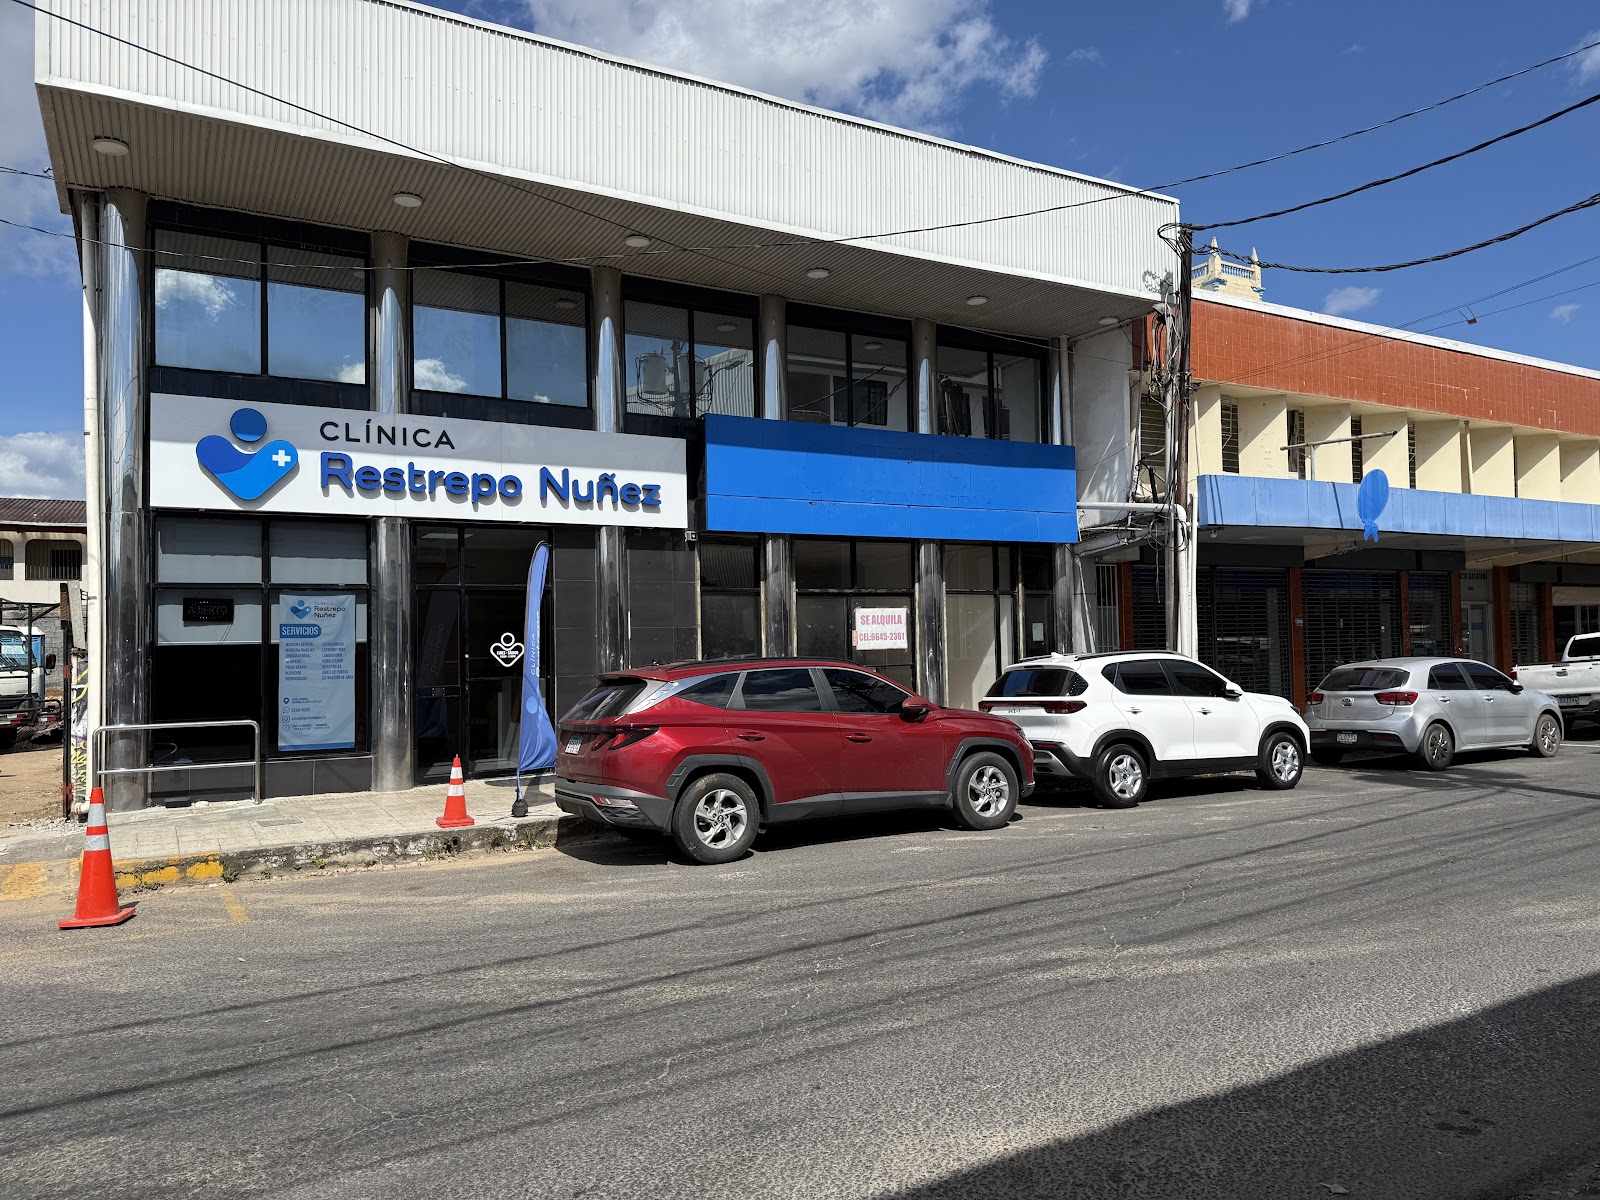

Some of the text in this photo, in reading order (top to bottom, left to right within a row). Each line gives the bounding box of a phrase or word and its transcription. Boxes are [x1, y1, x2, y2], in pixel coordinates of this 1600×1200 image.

[320, 418, 455, 450] CLÍNICA
[321, 452, 661, 506] Restrepo Nuñez
[860, 615, 902, 626] SE ALQUILA
[282, 626, 319, 635] SERVICIOS
[859, 632, 905, 641] CEL:6645-2361
